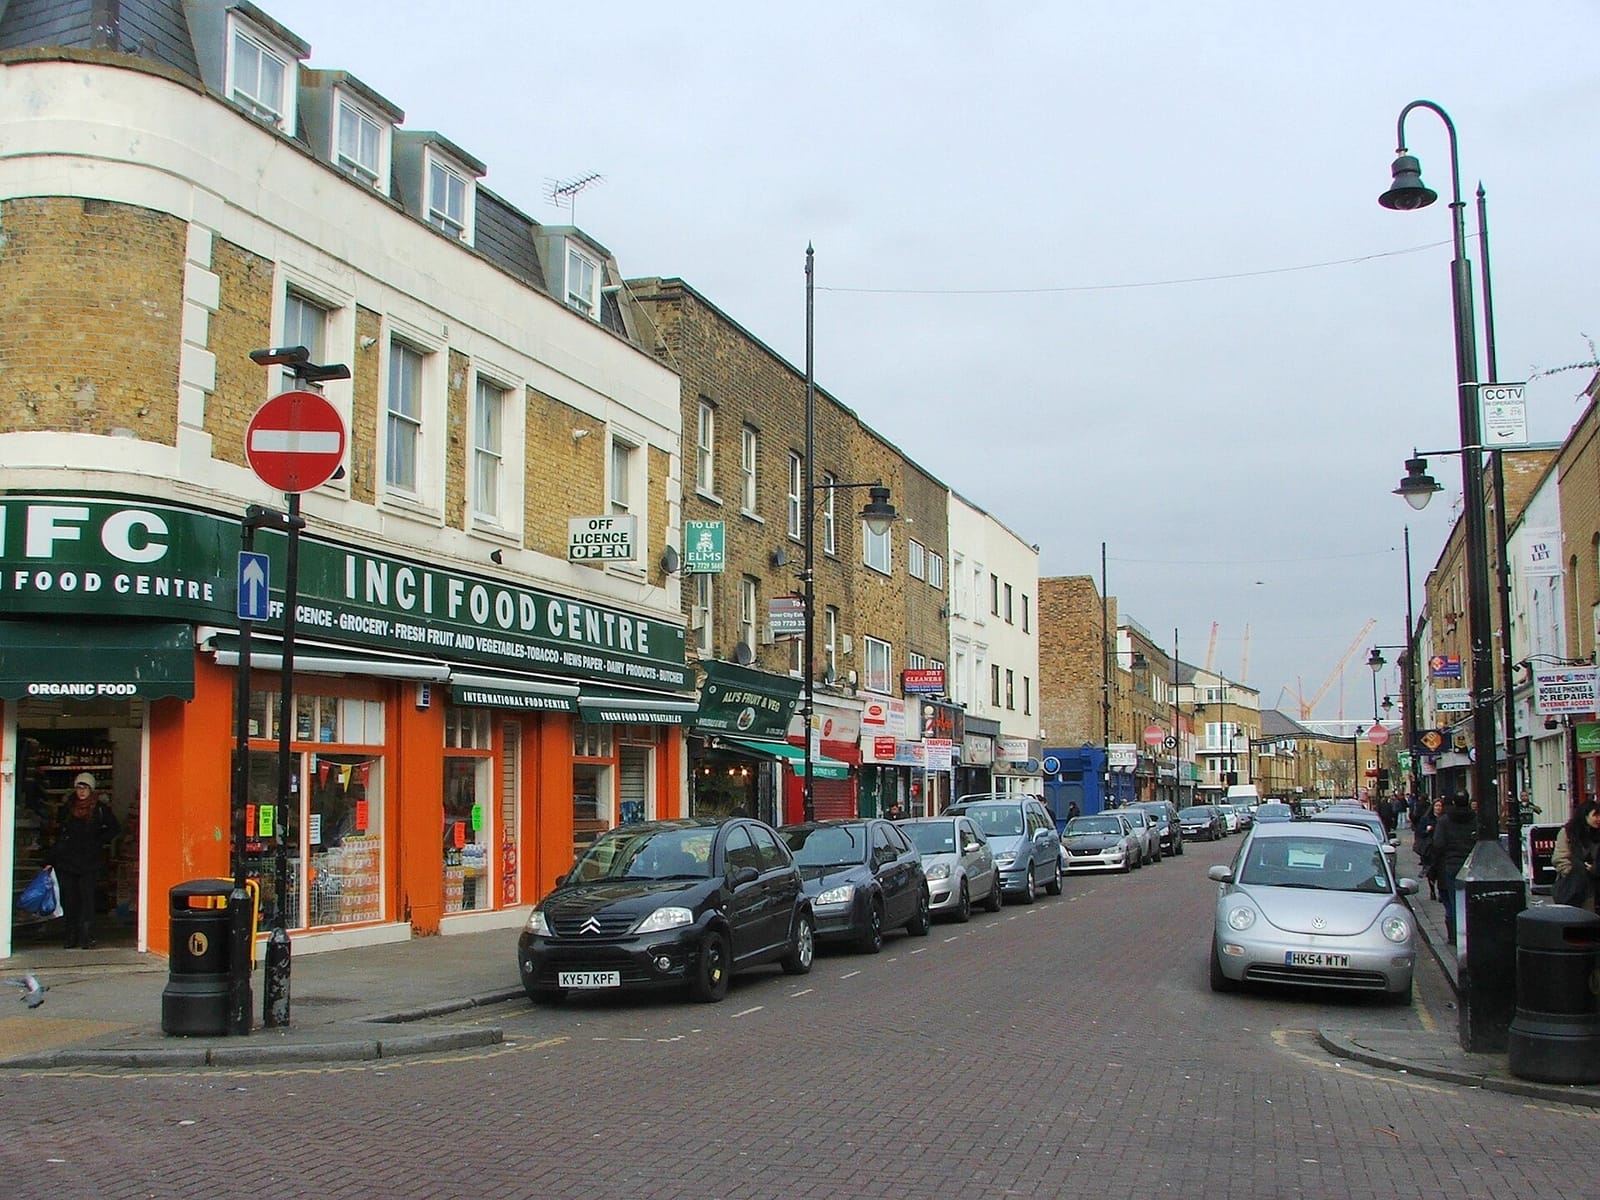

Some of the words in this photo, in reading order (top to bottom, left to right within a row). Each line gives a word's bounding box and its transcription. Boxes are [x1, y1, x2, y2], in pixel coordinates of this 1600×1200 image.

[1485, 388, 1522, 400] CCTV
[589, 519, 613, 530] OFF
[691, 521, 703, 529] TO
[705, 521, 720, 529] LET
[0, 505, 168, 563] FC
[573, 532, 628, 544] LICENCE
[572, 545, 628, 558] OPEN
[1531, 543, 1546, 552] TO
[688, 552, 722, 561] ELMS
[1531, 550, 1551, 561] LET
[14, 571, 101, 592] FOOD
[114, 574, 213, 601] CENTRE
[345, 554, 433, 613] INCI
[448, 578, 537, 631] FOOD
[548, 600, 649, 654] CENTRE
[269, 600, 284, 618] FF
[296, 605, 332, 627] CENCE
[340, 613, 389, 636] GROCERY
[395, 623, 425, 643] FRESH
[427, 629, 455, 648] FRUIT
[455, 633, 474, 649] AND
[563, 652, 582, 667] NEWS
[583, 656, 603, 671] PAPER
[607, 660, 625, 674] DAIRY
[625, 664, 656, 680] PRODUCTS
[659, 670, 684, 684] BUTCHER
[28, 683, 94, 695] ORGANIC
[97, 683, 137, 695] FOOD
[1562, 685, 1587, 693] PHONES
[463, 691, 524, 707] INTERNATIONAL
[525, 696, 543, 708] FOOD
[543, 698, 570, 710] CENTRE
[722, 692, 742, 703] ALI'S
[741, 692, 762, 706] FRUIT
[767, 699, 780, 712] VEG
[1550, 693, 1595, 701] REPAIRS
[600, 711, 621, 721] FRESH
[621, 712, 637, 722] FOOD
[638, 712, 650, 722] AND
[650, 713, 682, 723] VEGETABLES
[1293, 953, 1321, 965] HK54
[562, 973, 590, 985] KY57
[593, 973, 614, 984] KPF
